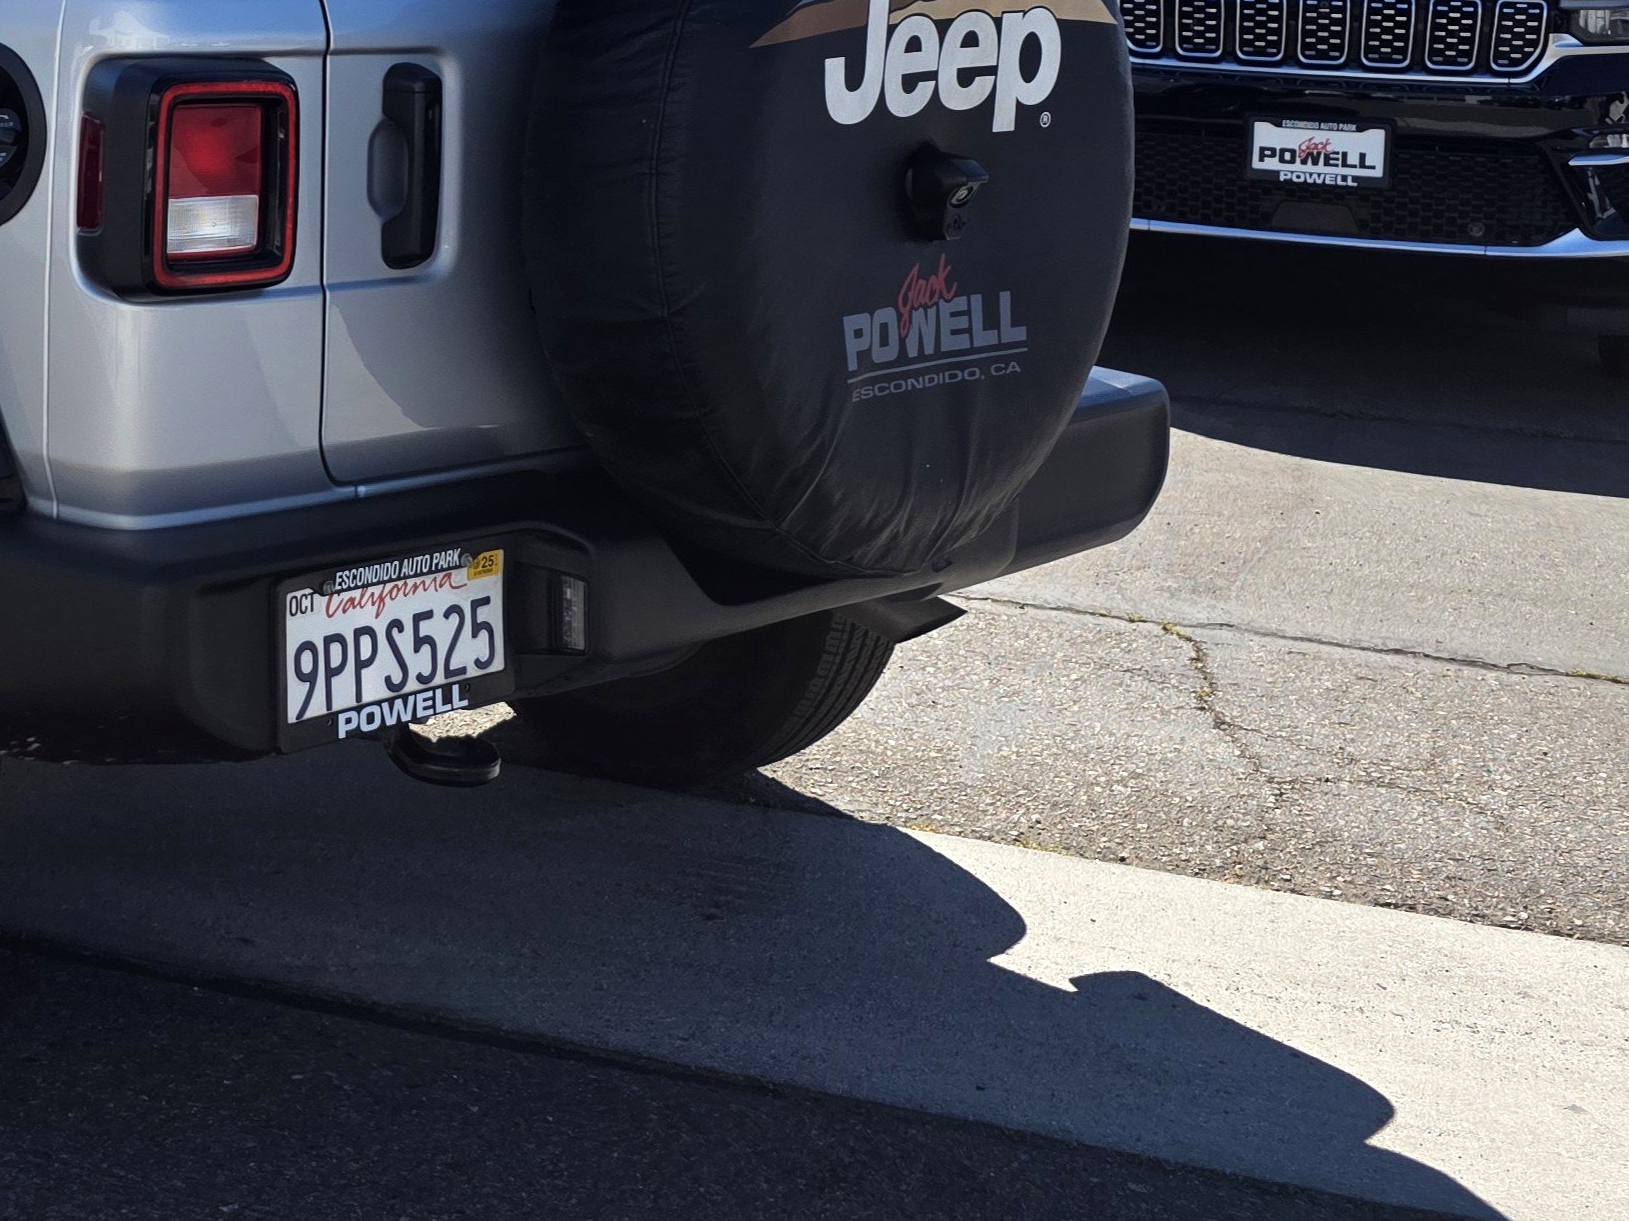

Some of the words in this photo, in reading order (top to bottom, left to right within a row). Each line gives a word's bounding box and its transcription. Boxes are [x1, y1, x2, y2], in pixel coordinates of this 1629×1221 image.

[1298, 136, 1332, 159] Jack
[1320, 122, 1337, 130] AUTO
[1339, 123, 1357, 132] PARK
[1258, 146, 1376, 170] POWELL
[1279, 171, 1358, 187] POWELL
[898, 252, 957, 338] Jack
[842, 290, 1028, 372] POWELL
[851, 367, 985, 403] ESCONDIDO,
[990, 361, 1022, 377] CA
[334, 560, 400, 590] ESCONDIDO
[400, 554, 431, 577] AUTO
[432, 547, 462, 571] PARK
[481, 555, 495, 569] 25
[289, 591, 317, 617] OCT
[325, 571, 468, 620] California
[293, 595, 496, 721] 9PPS525
[337, 684, 469, 739] POWELL
